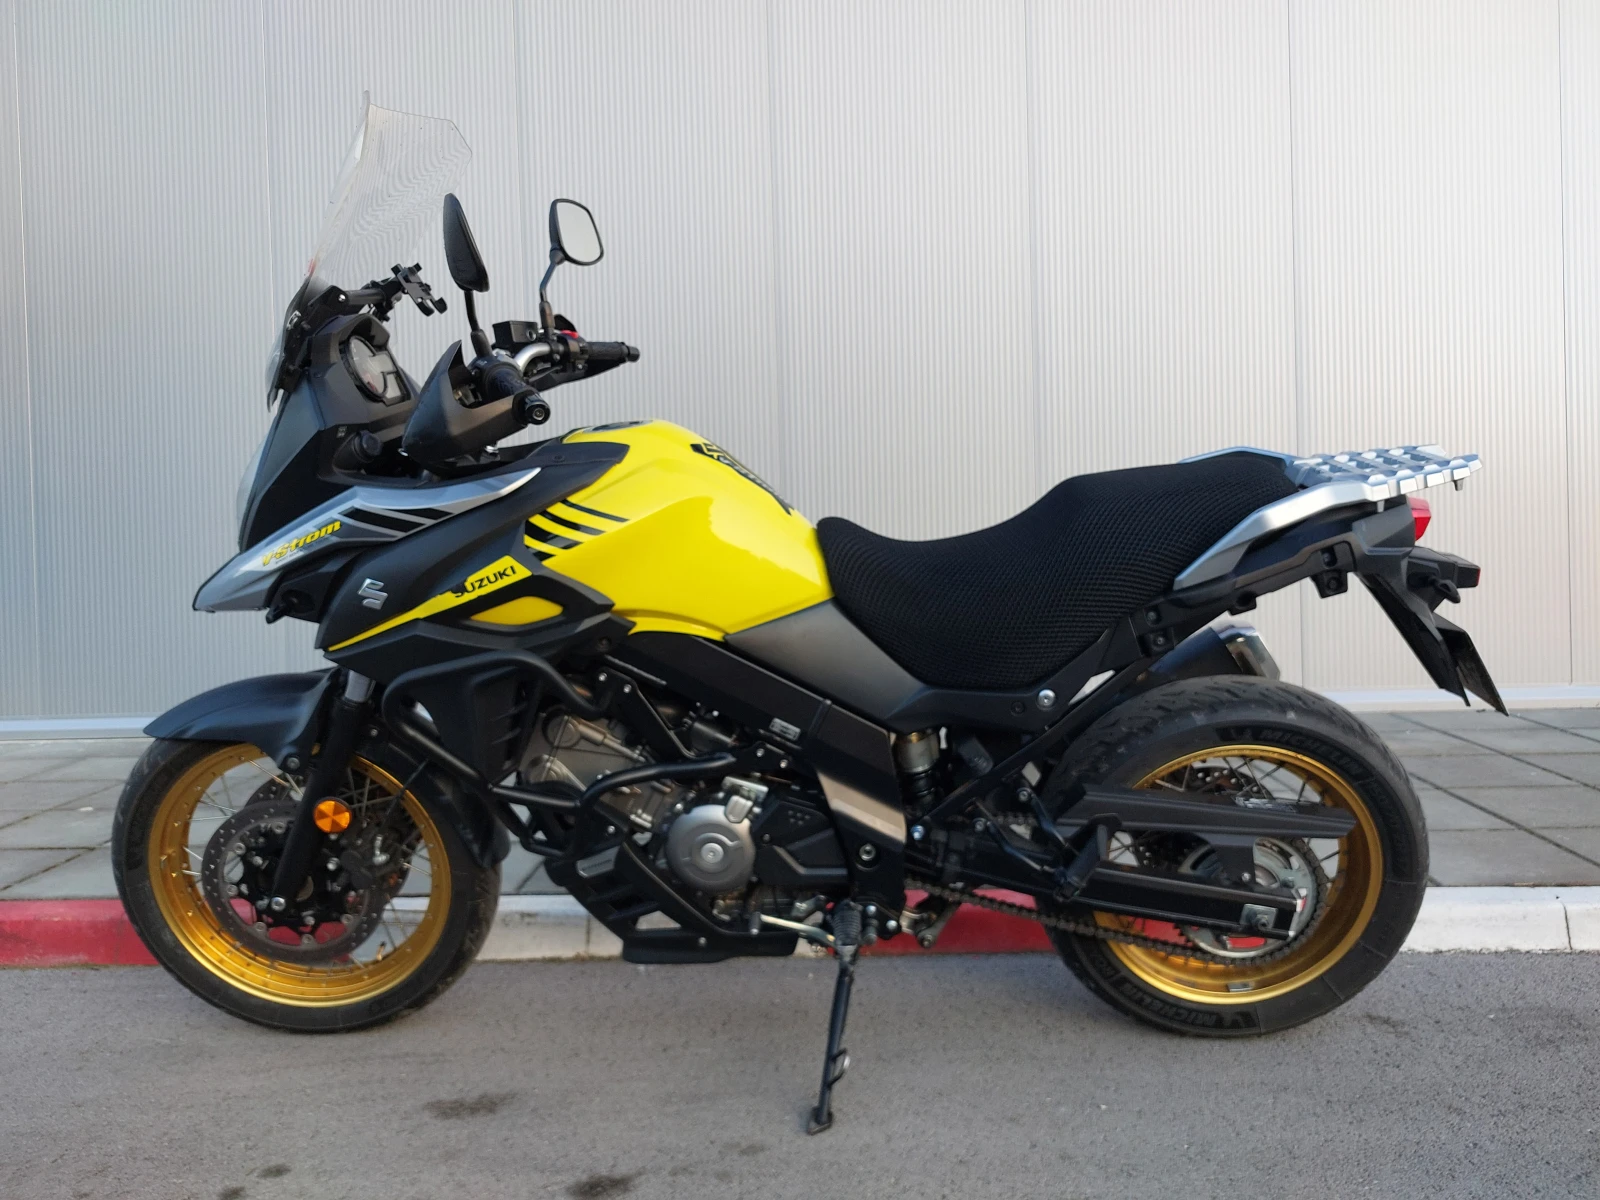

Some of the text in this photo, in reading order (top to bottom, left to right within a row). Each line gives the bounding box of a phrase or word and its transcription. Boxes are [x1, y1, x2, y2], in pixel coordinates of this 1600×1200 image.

[452, 565, 517, 598] SUZUKI
[1258, 727, 1368, 783] MICHELIN
[1115, 979, 1217, 1027] MICHELIN
